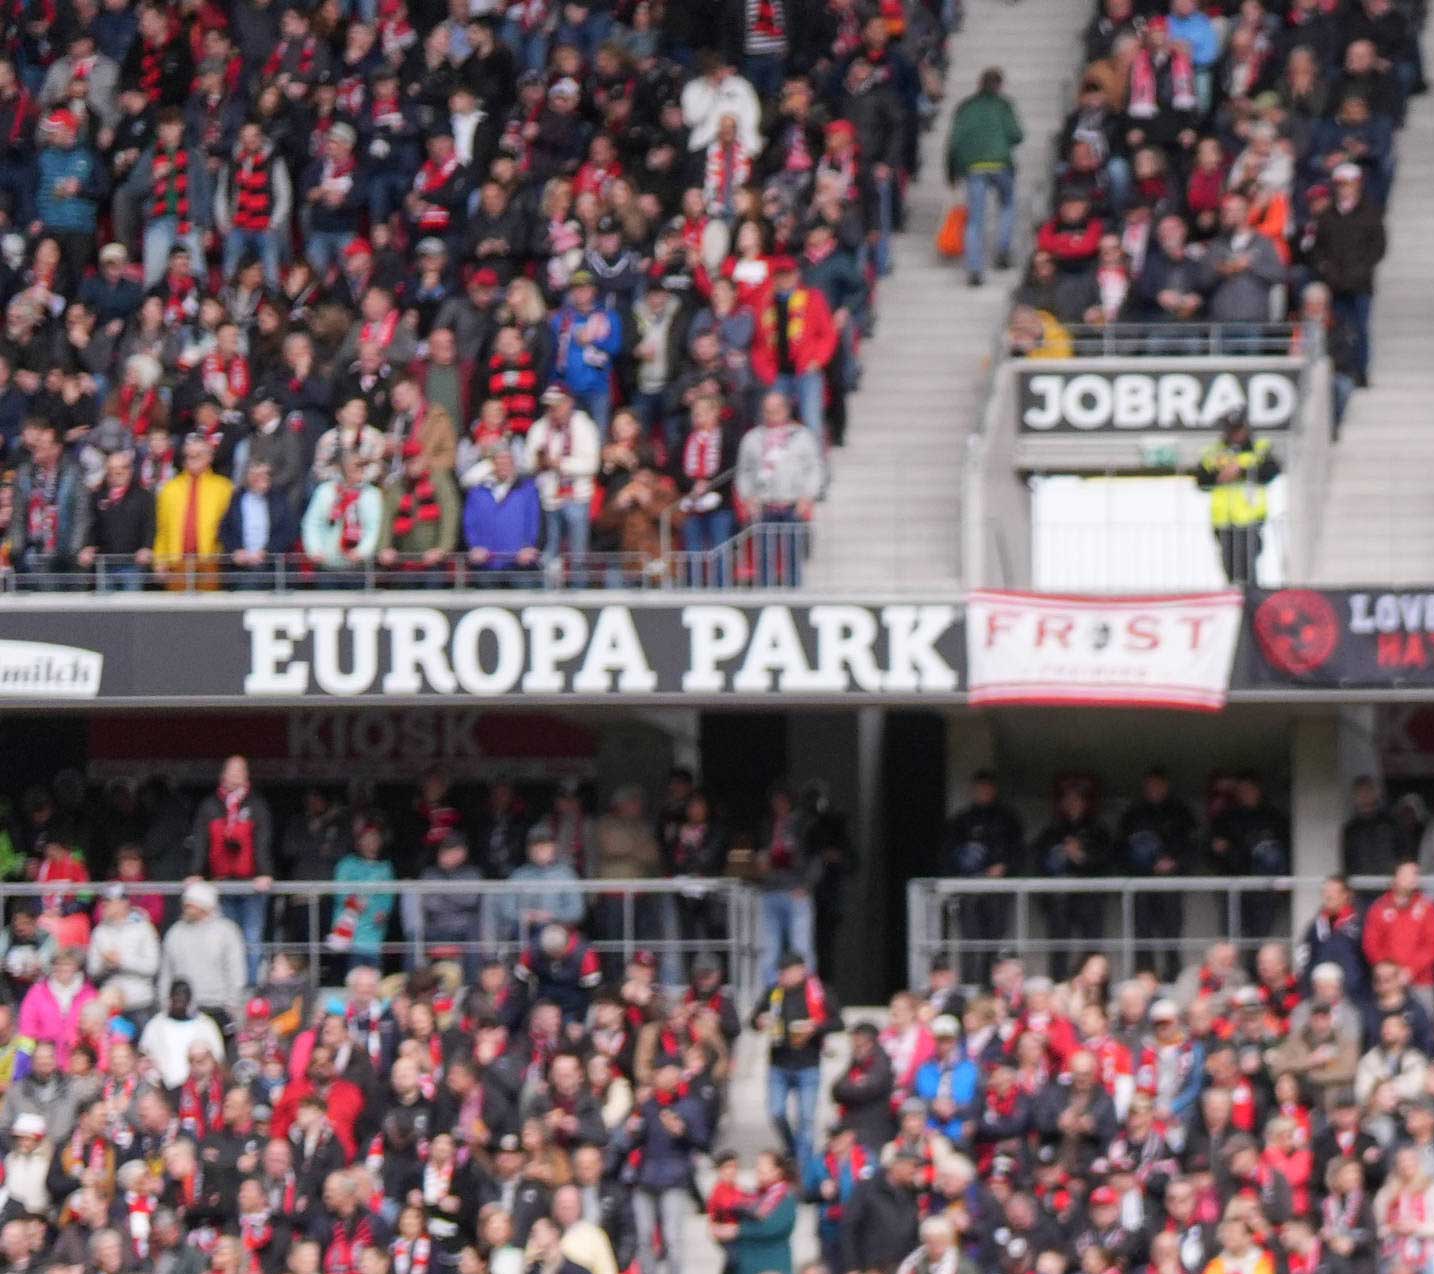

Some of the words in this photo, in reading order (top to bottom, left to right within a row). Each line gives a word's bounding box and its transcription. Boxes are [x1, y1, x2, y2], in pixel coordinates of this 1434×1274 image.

[1023, 373, 1297, 430] JOBRAD
[243, 606, 658, 697] EUROPA
[681, 604, 958, 694] PARK
[288, 710, 484, 758] KIOSK
